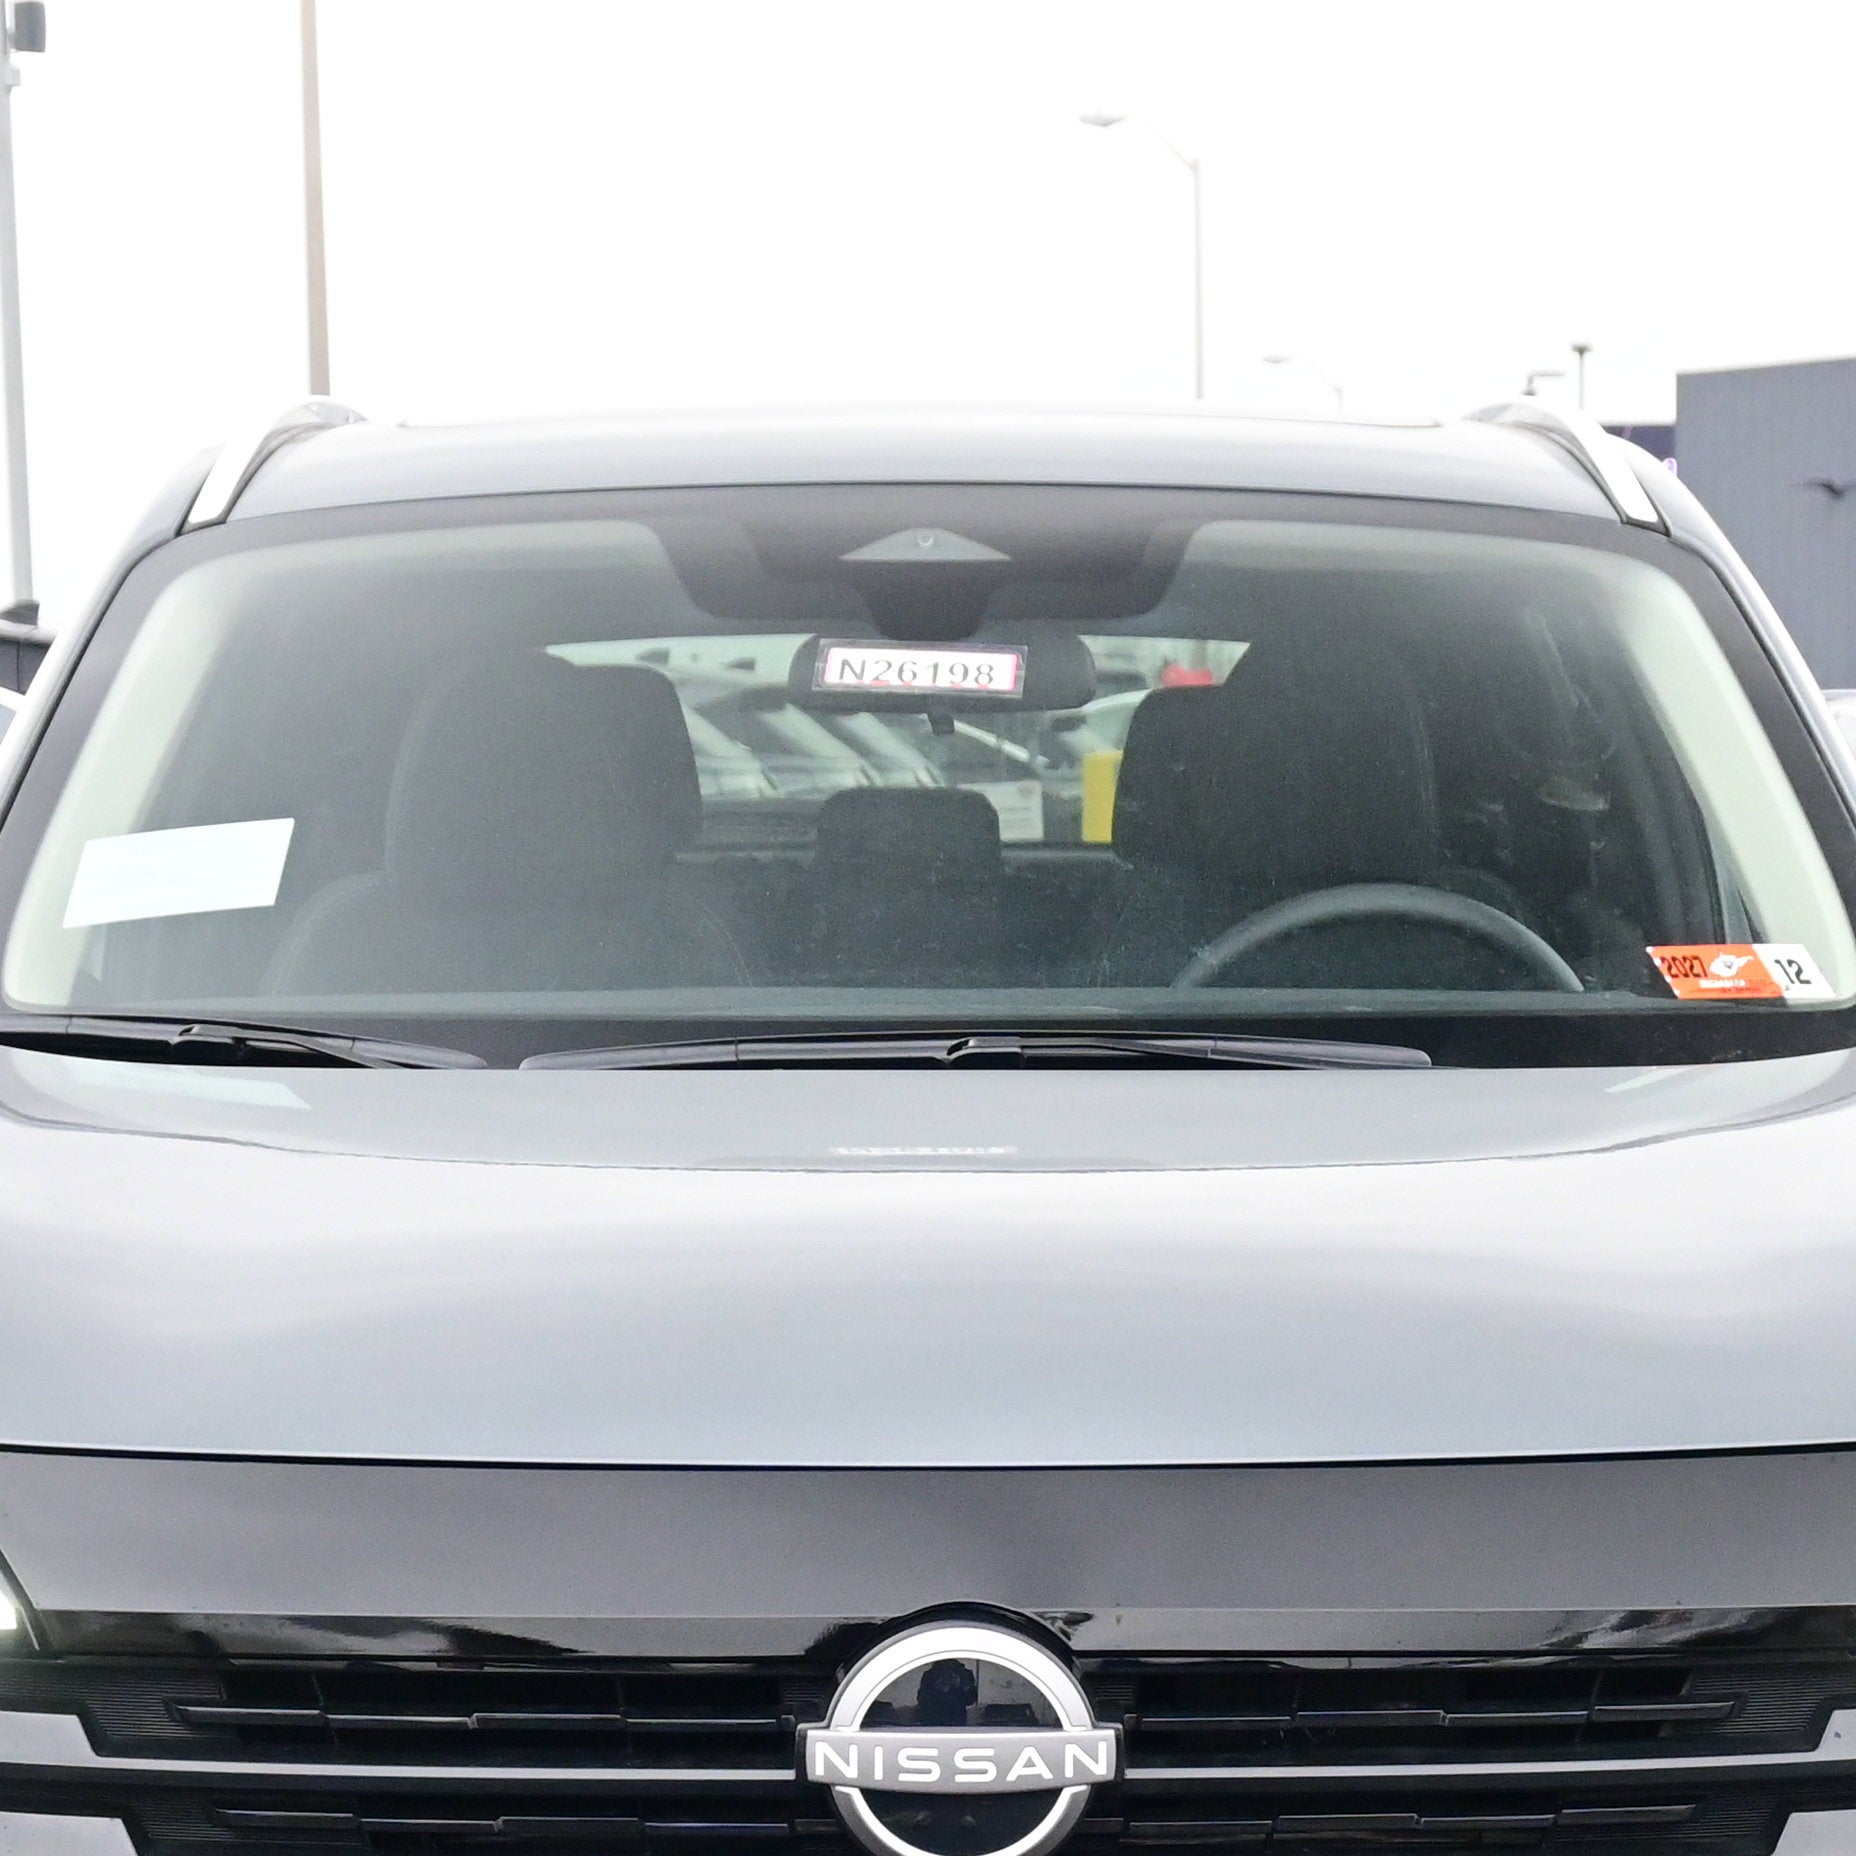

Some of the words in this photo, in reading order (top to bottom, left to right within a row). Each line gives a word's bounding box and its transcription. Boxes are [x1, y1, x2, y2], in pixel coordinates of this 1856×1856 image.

[839, 658, 996, 686] N26198
[1660, 955, 1709, 979] 2027
[1774, 958, 1813, 985] 12
[814, 1740, 1108, 1783] NISSAN
